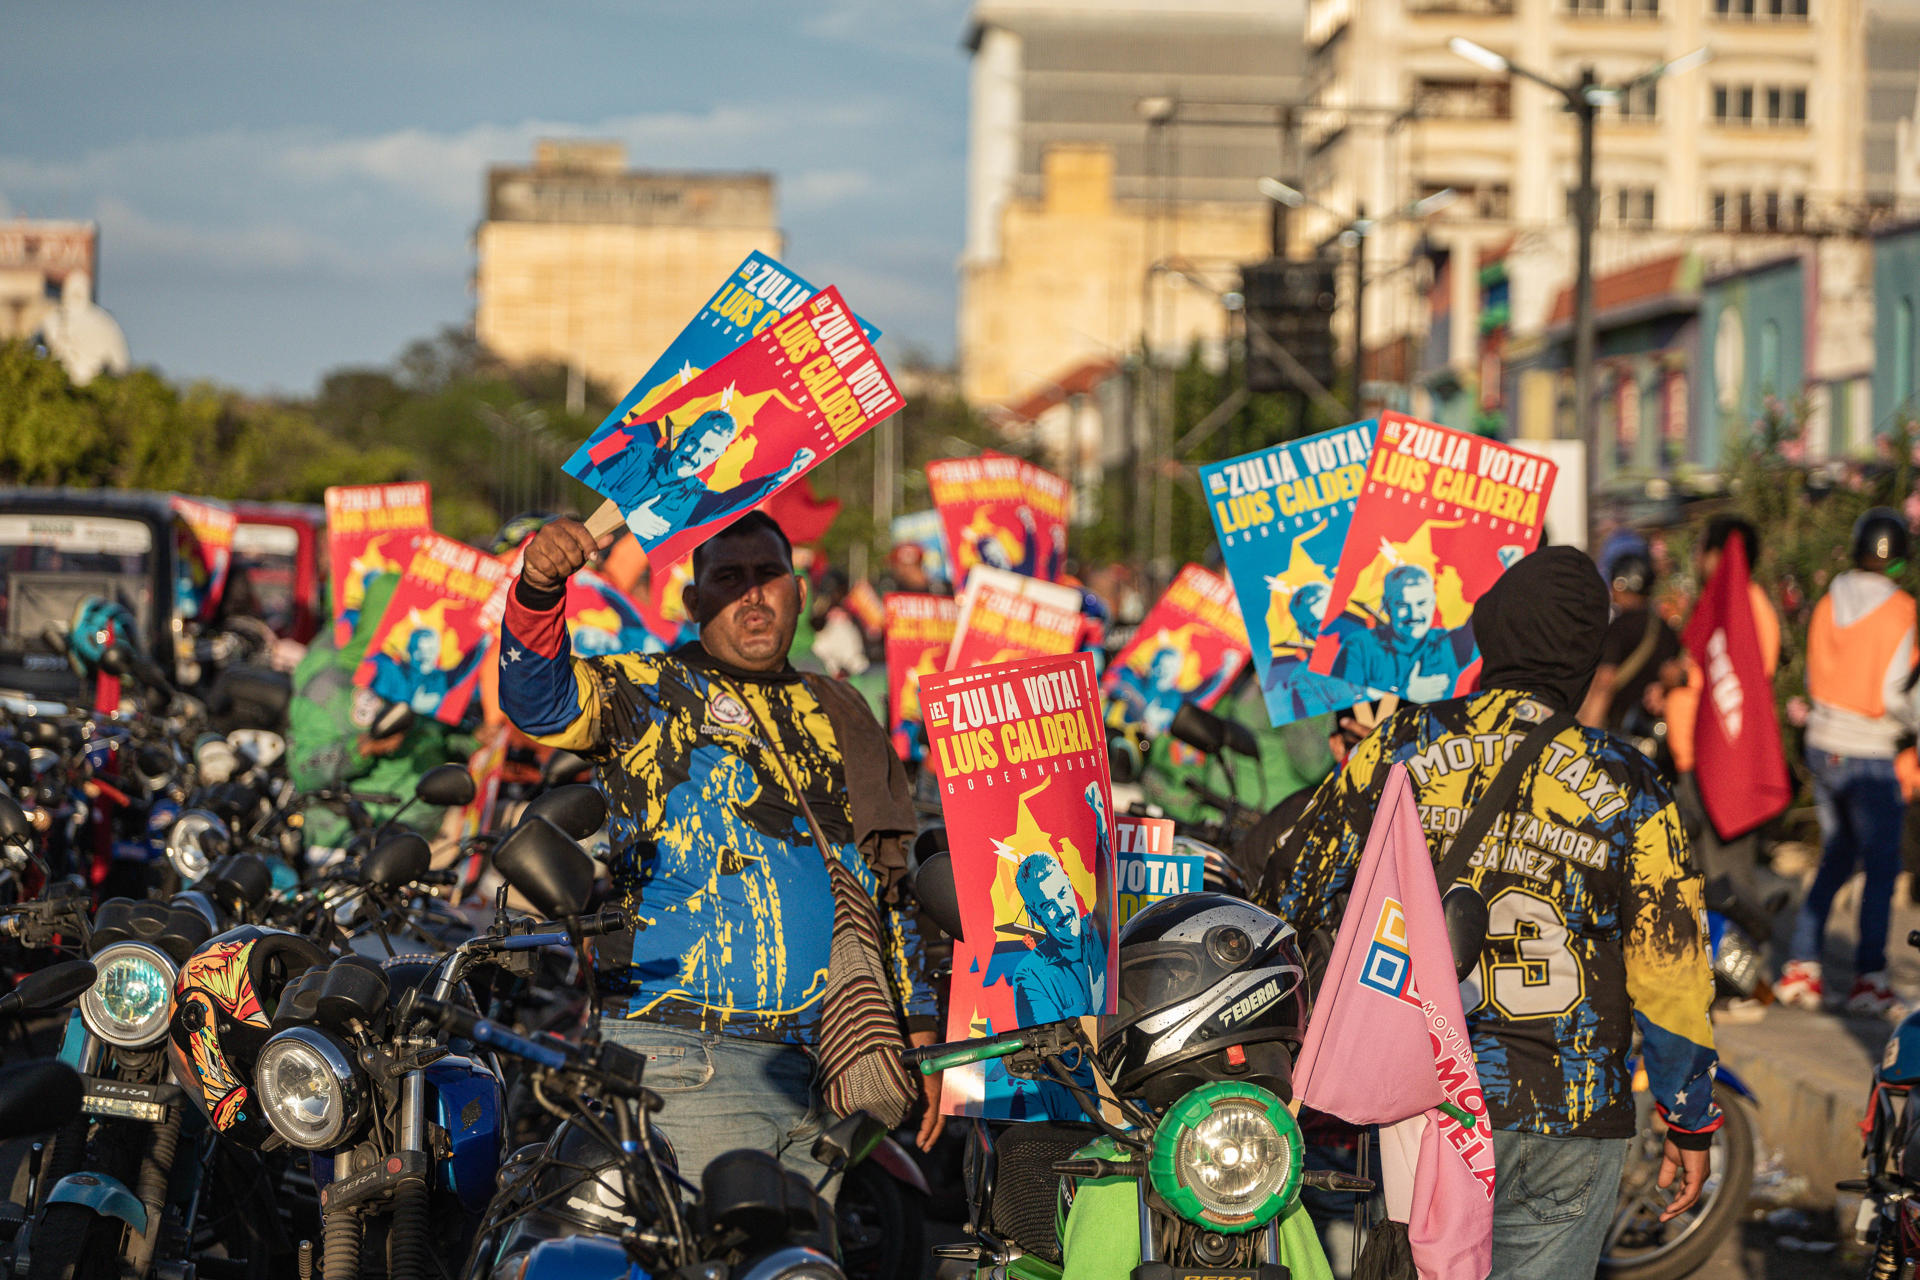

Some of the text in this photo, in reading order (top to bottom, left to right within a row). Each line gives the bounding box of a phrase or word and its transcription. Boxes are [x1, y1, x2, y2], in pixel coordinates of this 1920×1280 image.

[710, 282, 764, 328] LUIS
[744, 263, 811, 314] ZULIA
[773, 311, 867, 443] LUIS CALDERA
[810, 304, 866, 370] ZULIA
[846, 359, 897, 420] VOTA!
[1223, 449, 1300, 497] ZULIA
[1300, 426, 1373, 475] VOTA!
[1371, 447, 1540, 527] LUIS CALDERA
[1397, 422, 1471, 471] ZULIA
[1477, 444, 1549, 493] VOTA!
[1216, 463, 1368, 534] LUIS CALDER
[929, 701, 948, 720] ¡EL
[946, 681, 1022, 732] ZULIA
[1022, 669, 1082, 715] VOTA!
[937, 709, 1093, 778] LUIS CALDERA
[1543, 741, 1627, 820] TAXI
[1510, 813, 1609, 870] ZAMORA
[1218, 978, 1281, 1028] FEDERAL
